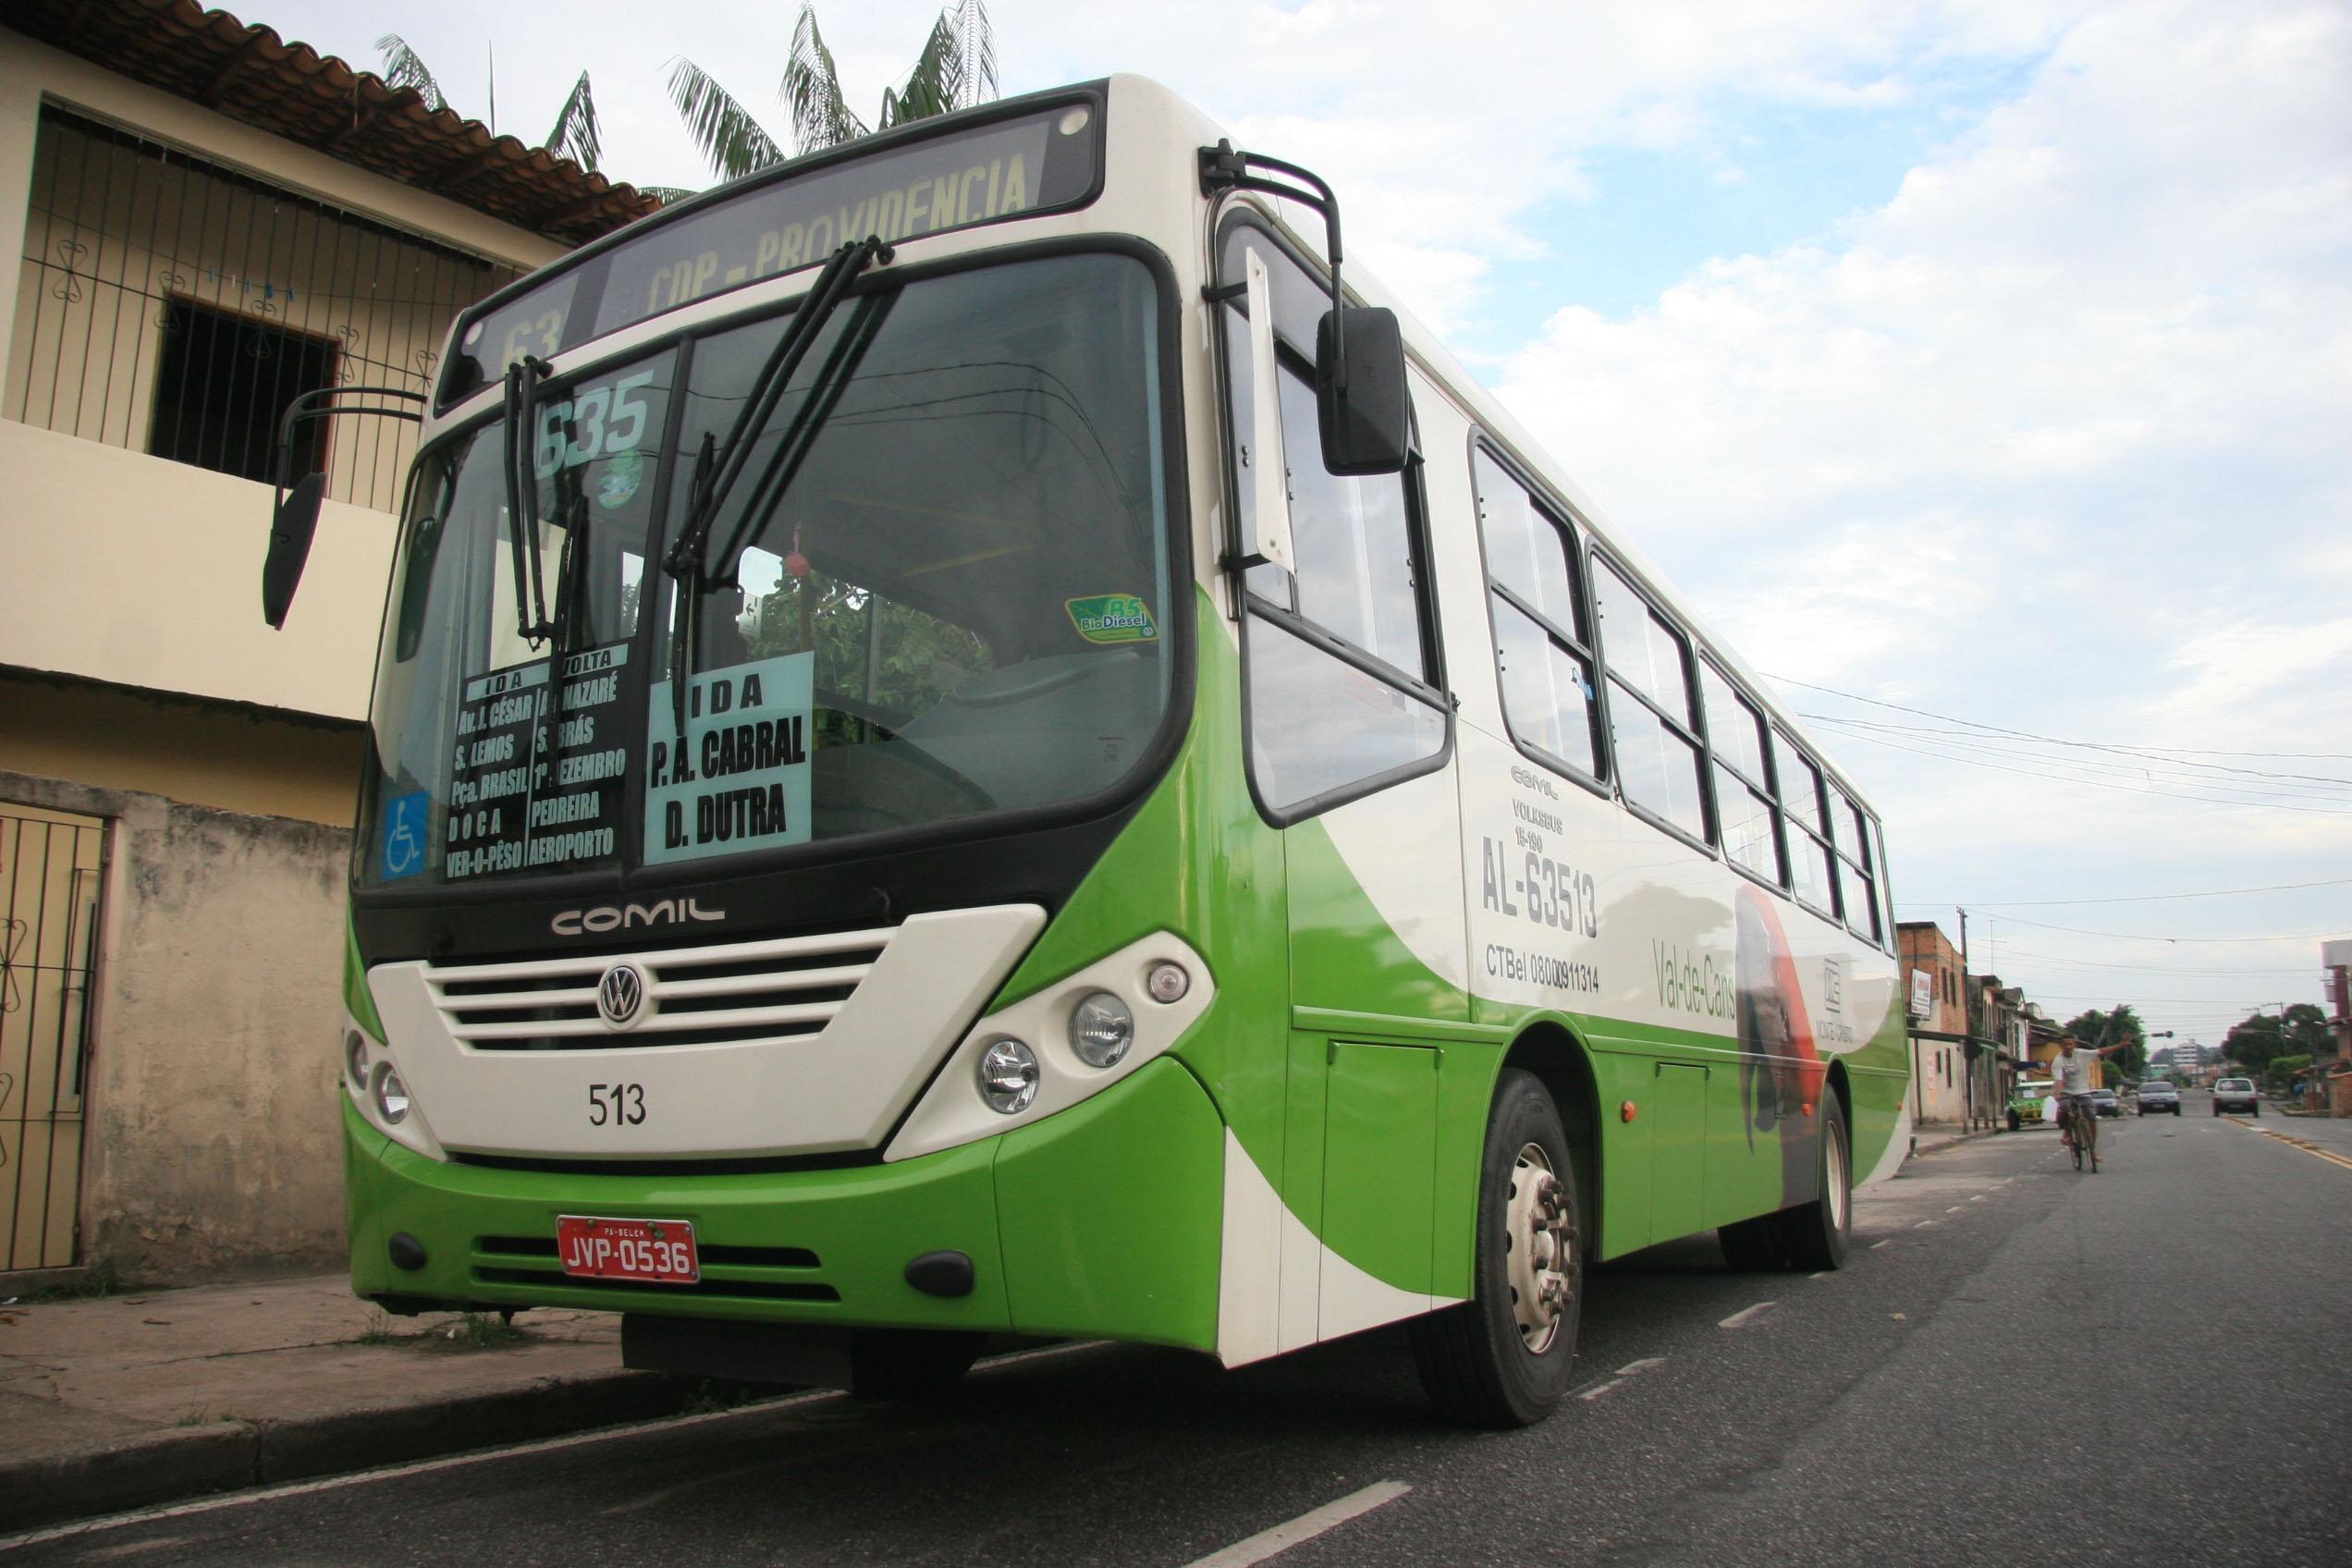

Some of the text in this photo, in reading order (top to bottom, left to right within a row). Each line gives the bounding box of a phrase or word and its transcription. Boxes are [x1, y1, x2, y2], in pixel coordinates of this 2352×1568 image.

[533, 369, 654, 481] 635
[1080, 612, 1146, 631] BioDiesel
[562, 670, 619, 712] NAZARÉ
[691, 672, 763, 719] IDA
[489, 695, 533, 729] CÉSAR
[455, 733, 514, 772] S. LEMOS
[536, 714, 594, 753] S. BRÁS
[651, 715, 805, 789] P. A. CABRAL
[451, 766, 528, 810] Pça. BRASIL
[1510, 765, 1560, 801] COMIL
[448, 808, 501, 843] DOCA
[531, 790, 600, 828] PEDREIRA
[666, 782, 786, 850] D. DUTRA
[1513, 798, 1563, 835] VOLKSBUS
[447, 839, 522, 878] VER-O-PÊSO
[529, 827, 614, 866] AEROPORTO
[1515, 826, 1543, 853] 15-190
[1483, 835, 1598, 938] AL-63513
[552, 898, 726, 936] COMIL
[1486, 942, 1527, 983] CTBel
[1651, 937, 1735, 1021] Val-de-Cans
[589, 1083, 646, 1126] 513
[605, 1227, 644, 1238] PA-BELEM
[567, 1237, 691, 1274] JVP-0536
